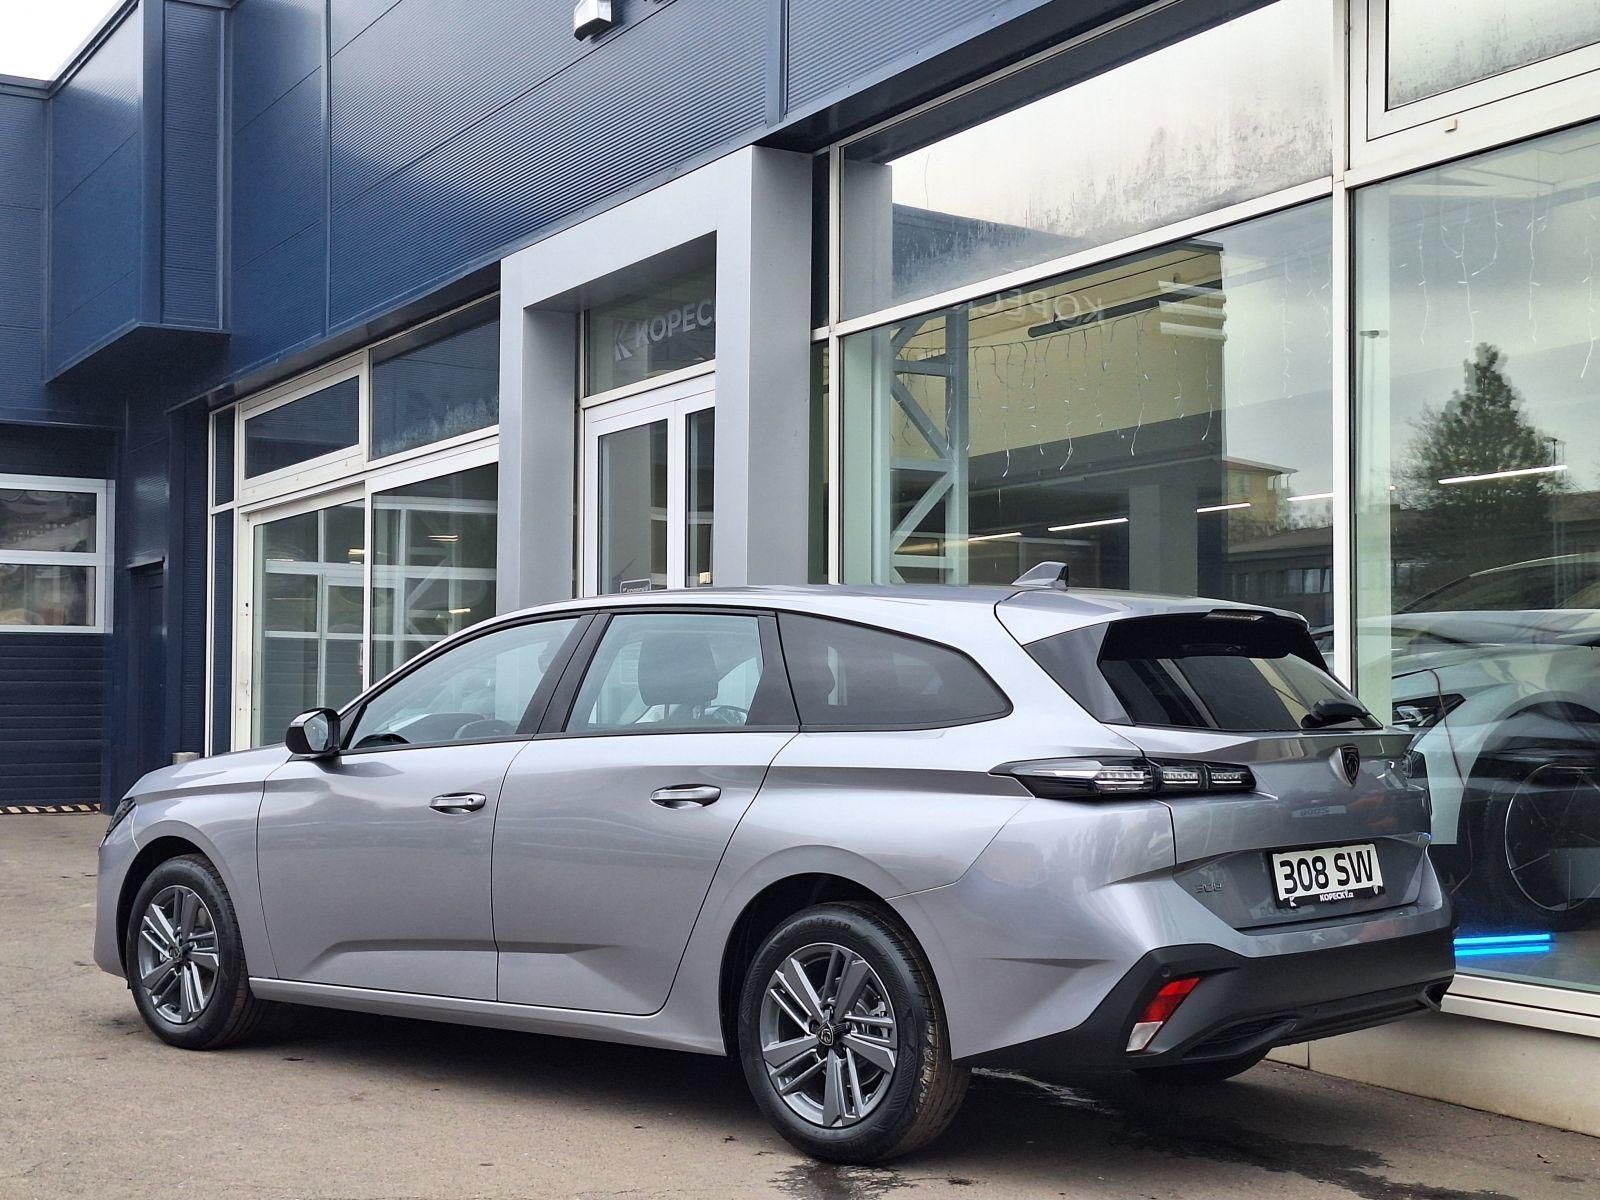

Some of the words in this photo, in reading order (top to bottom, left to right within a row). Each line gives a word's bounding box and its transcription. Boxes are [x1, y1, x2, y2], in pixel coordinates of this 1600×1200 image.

[635, 298, 716, 348] KOPEC
[1279, 855, 1329, 895] 308
[1334, 850, 1373, 887] SW
